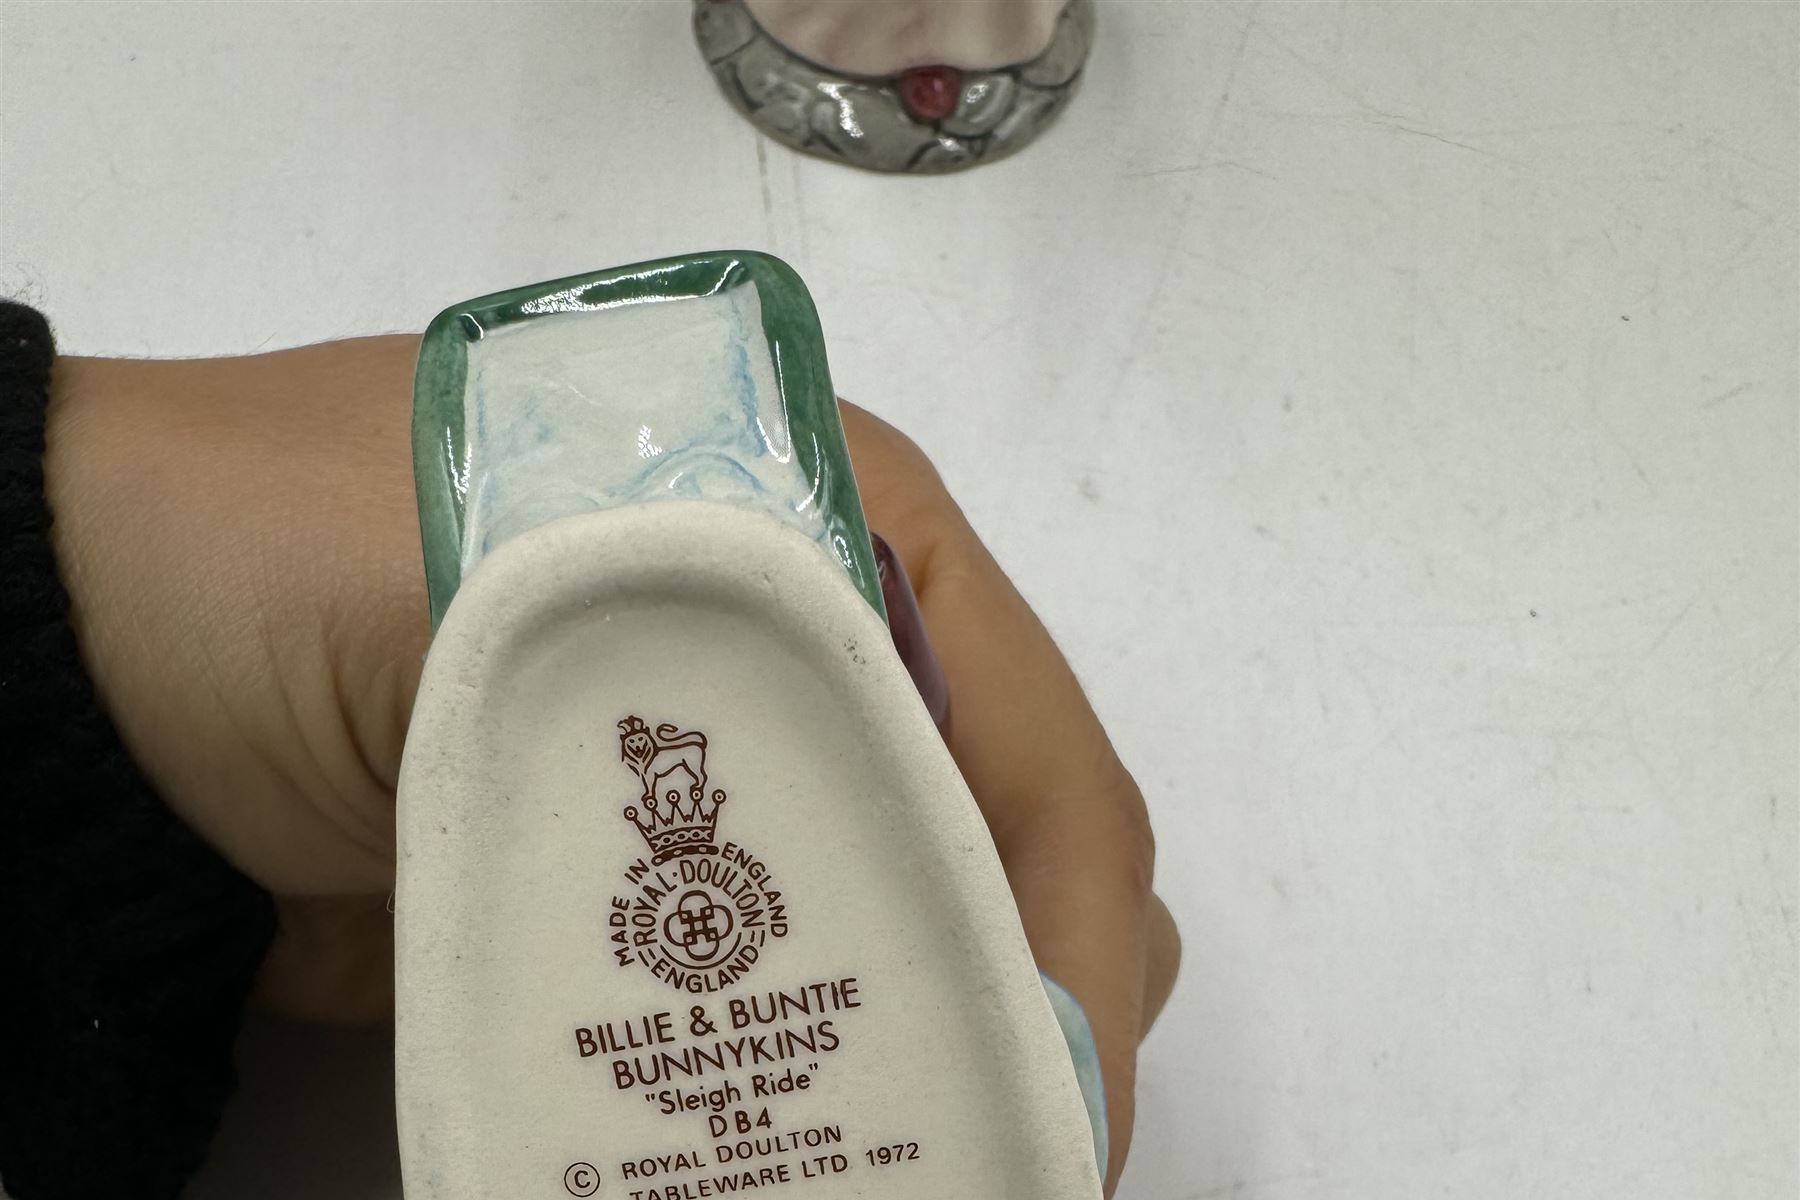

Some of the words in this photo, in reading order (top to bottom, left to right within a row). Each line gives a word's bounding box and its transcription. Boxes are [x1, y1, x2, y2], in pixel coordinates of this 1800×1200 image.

[609, 896, 636, 968] MADE
[624, 858, 651, 886] IN
[721, 842, 789, 939] ENGLAND
[631, 872, 678, 948] ROYAL
[680, 858, 767, 929] DOULTON
[651, 945, 760, 994] ENGLAND
[575, 1011, 676, 1059] BILLIE
[690, 1005, 719, 1037] &
[728, 977, 862, 1031] BUNTIE
[612, 1020, 840, 1091] BUNNYKINS
[645, 1079, 742, 1116] "Sleigh
[752, 1062, 820, 1099] Ride"
[621, 1150, 707, 1181] ROYAL
[715, 1125, 842, 1164] DOULTON
[801, 1153, 849, 1179] LTD
[865, 1142, 921, 1168] 1972
